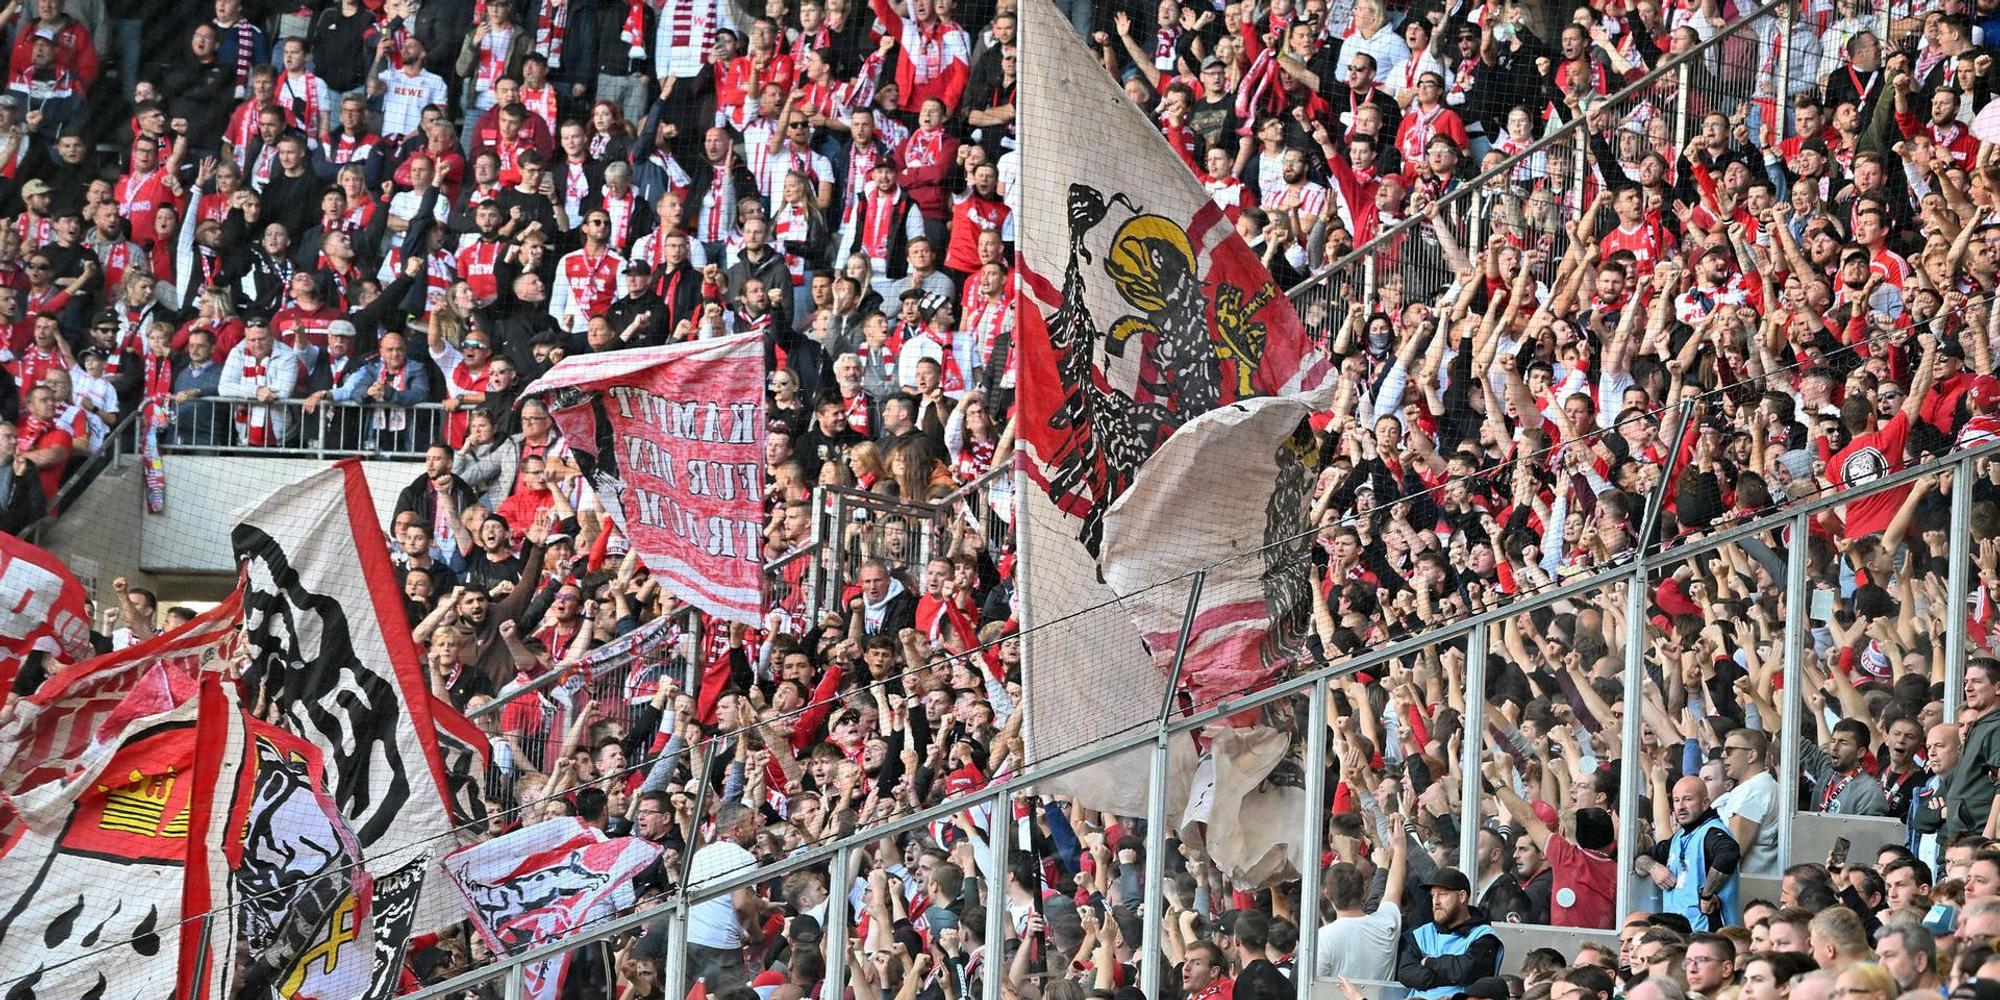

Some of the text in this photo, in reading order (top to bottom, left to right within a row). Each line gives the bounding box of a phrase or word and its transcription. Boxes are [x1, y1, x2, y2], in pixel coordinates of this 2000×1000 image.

[394, 87, 424, 99] REWE
[468, 263, 494, 275] REW
[571, 277, 606, 292] REE
